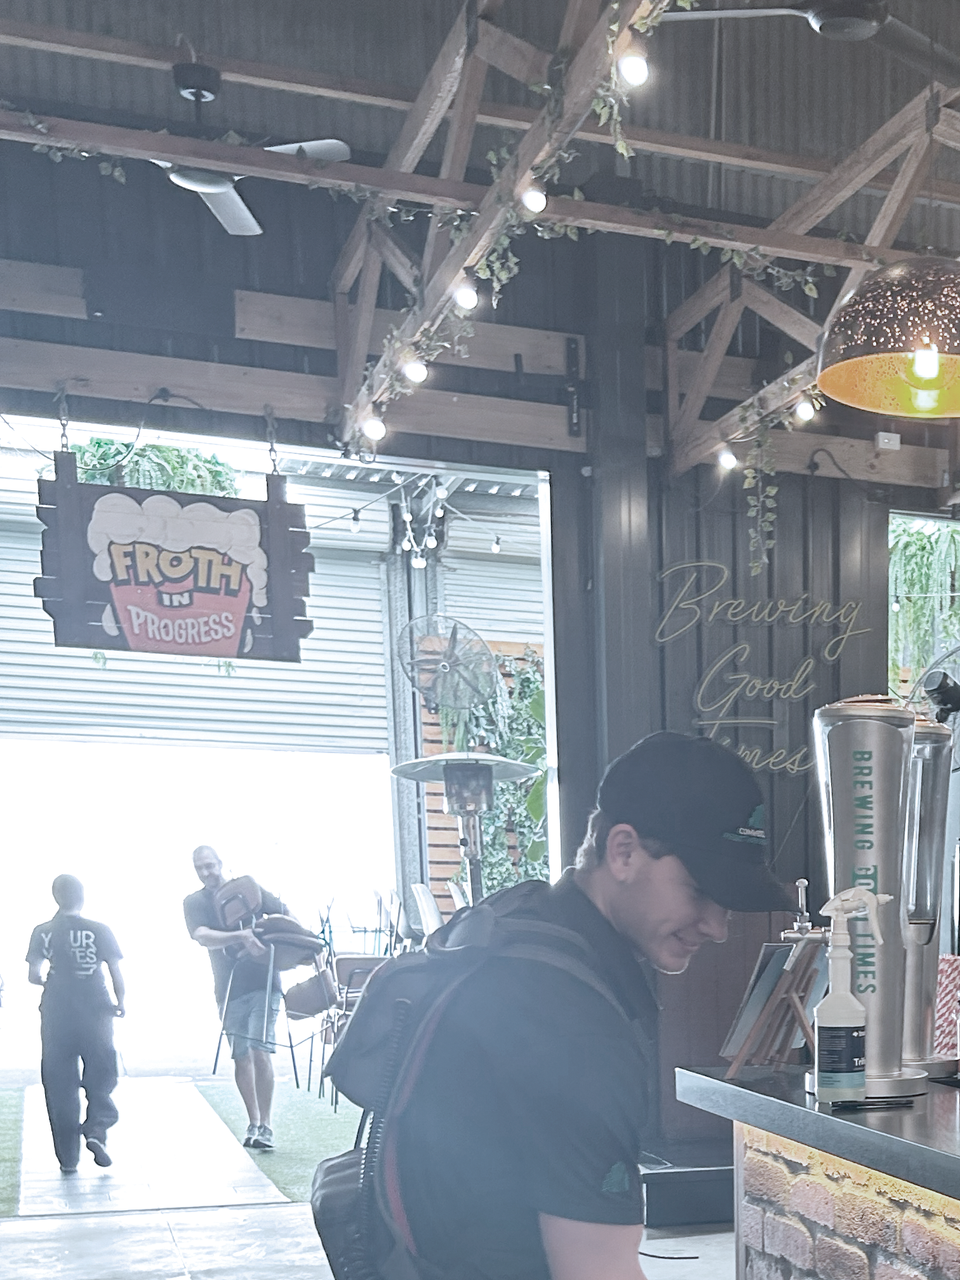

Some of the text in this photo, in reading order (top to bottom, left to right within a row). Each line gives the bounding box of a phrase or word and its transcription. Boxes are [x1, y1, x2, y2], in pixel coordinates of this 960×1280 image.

[109, 542, 243, 591] FROTH
[126, 604, 236, 645] PROGRESS
[162, 590, 191, 607] IN
[655, 561, 872, 661] Brewing
[697, 643, 816, 718] Good
[697, 720, 815, 774] Tmes
[852, 750, 875, 850] BREWING
